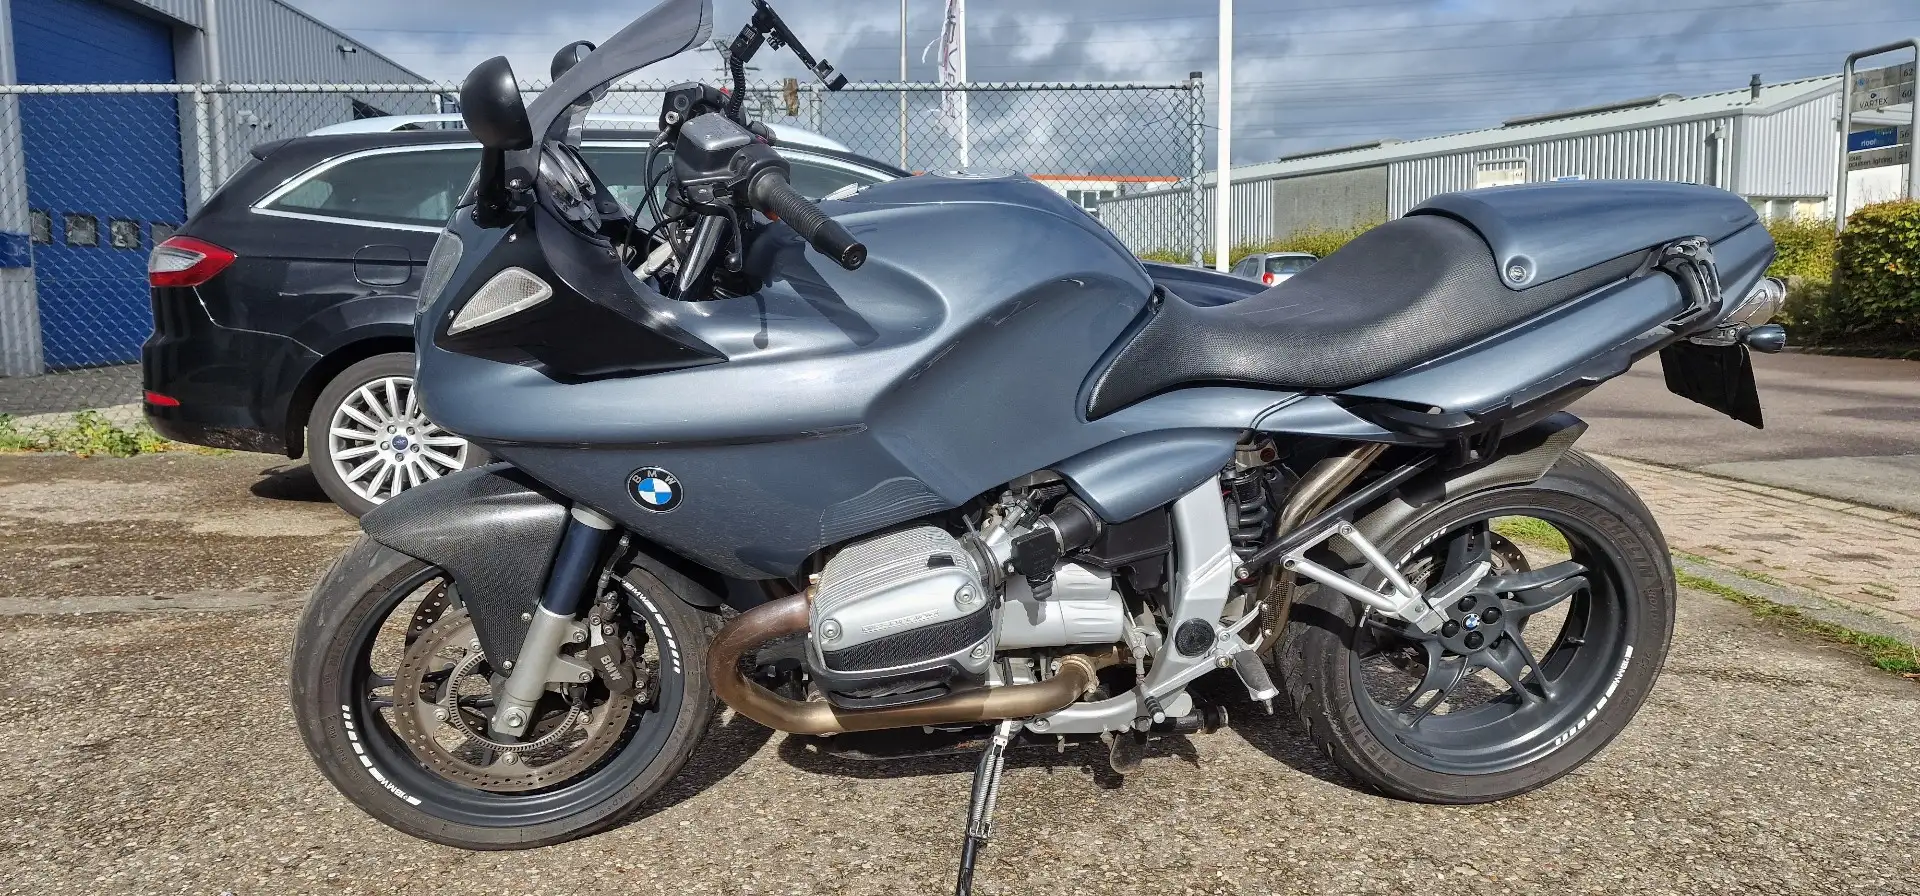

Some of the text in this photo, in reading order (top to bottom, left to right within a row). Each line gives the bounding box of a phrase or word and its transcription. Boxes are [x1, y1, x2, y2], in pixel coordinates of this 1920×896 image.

[1903, 68, 1914, 77] 62
[1901, 89, 1913, 98] 60
[1859, 97, 1888, 109] VARTEX
[632, 470, 677, 484] BMW
[1571, 502, 1654, 579] MICHELIN
[600, 654, 622, 681] BMW
